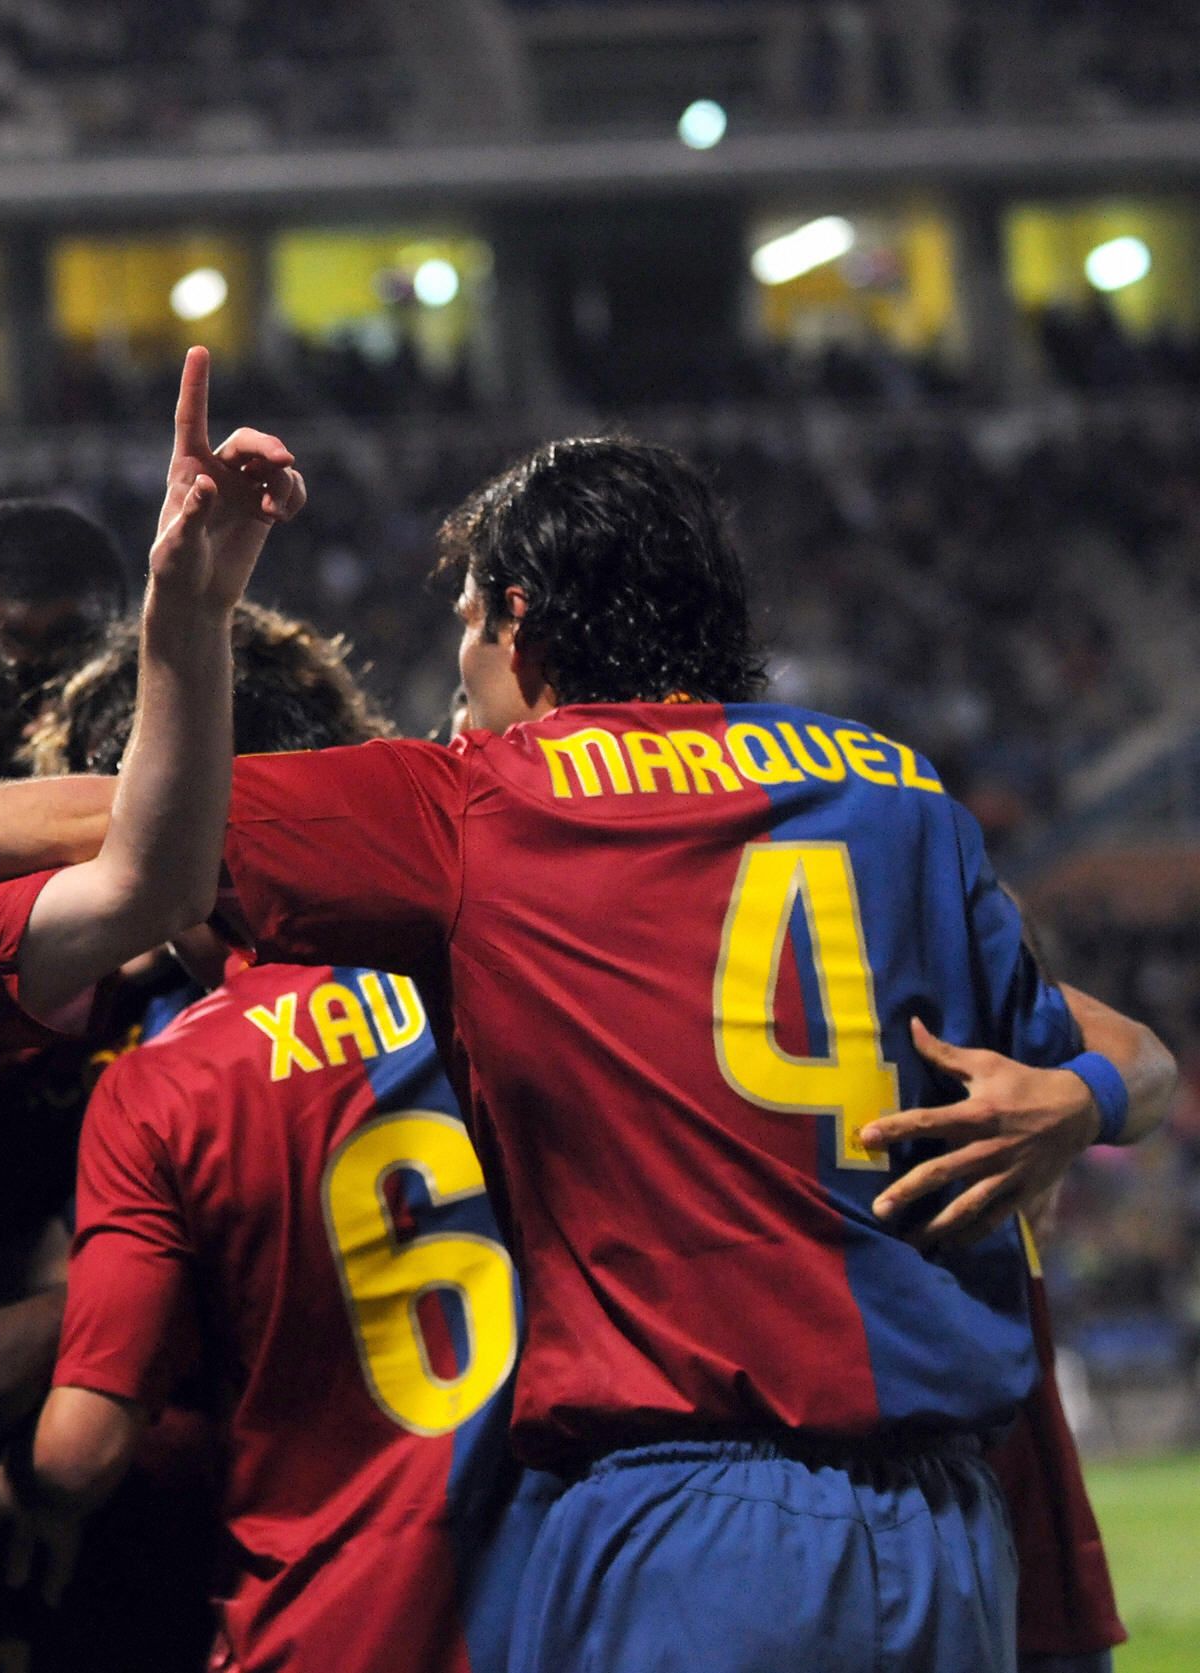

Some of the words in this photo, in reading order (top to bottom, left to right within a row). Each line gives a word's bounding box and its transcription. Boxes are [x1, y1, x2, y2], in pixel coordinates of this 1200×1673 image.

[537, 722, 943, 798] MARQUEZ
[243, 971, 427, 1082] XAV
[712, 840, 899, 1171] 4
[321, 1111, 519, 1438] 6
